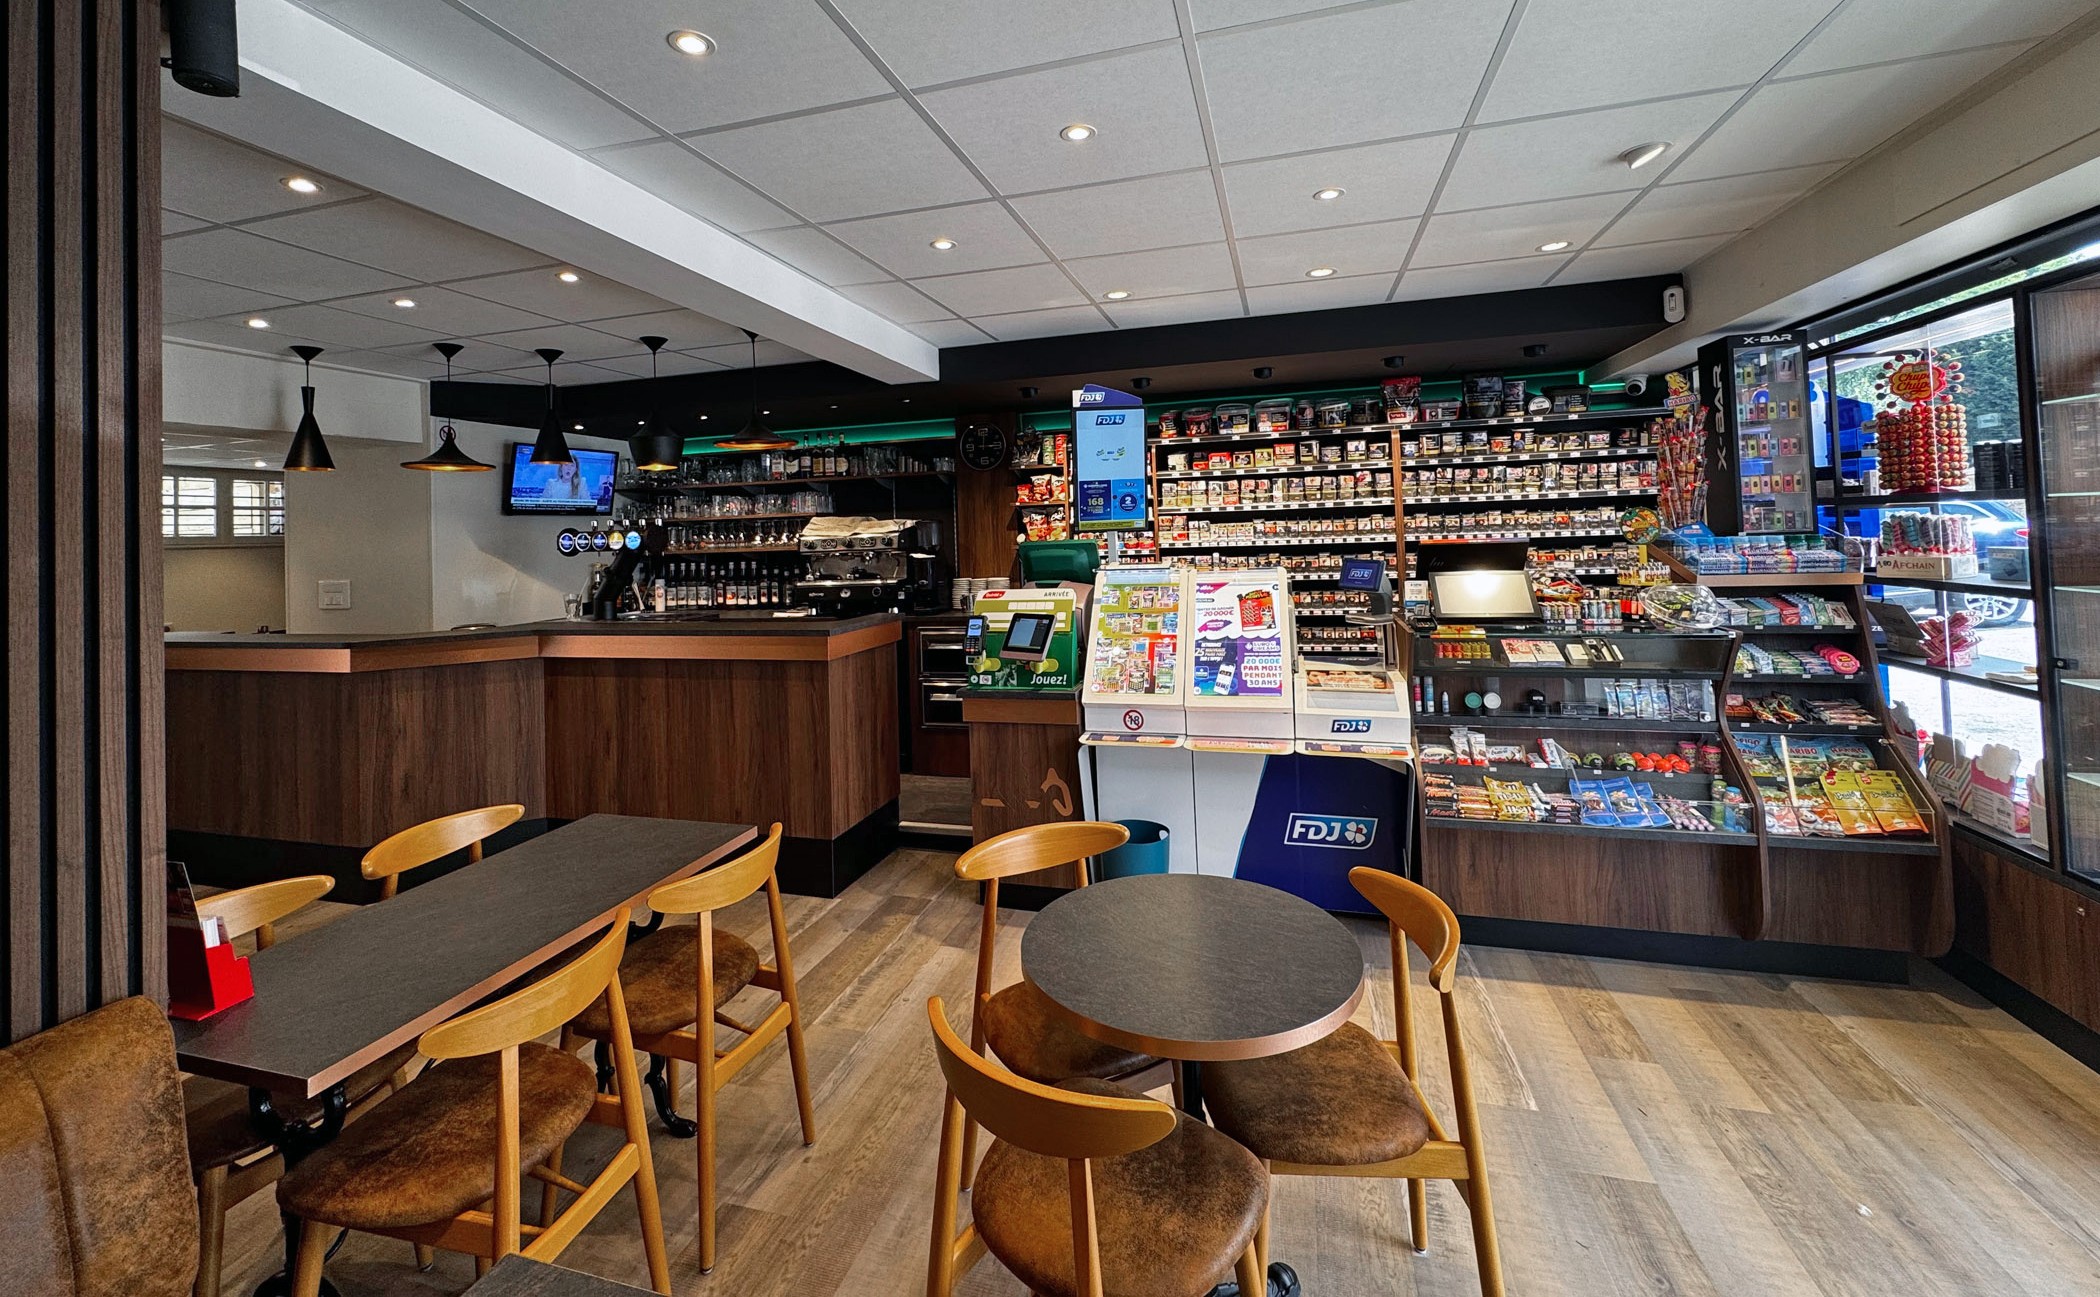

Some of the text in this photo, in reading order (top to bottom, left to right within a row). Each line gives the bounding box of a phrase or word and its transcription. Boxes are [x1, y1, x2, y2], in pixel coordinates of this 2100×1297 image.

[1743, 333, 1793, 345] X-BAR
[1080, 394, 1095, 402] FDJ
[1097, 416, 1115, 425] FDJ
[1712, 363, 1728, 471] X-BAR
[1087, 497, 1104, 506] 168
[1891, 558, 1935, 570] AFCHAIN
[1349, 569, 1363, 578] FDJ
[1194, 648, 1205, 657] 25
[1030, 674, 1067, 685] Jouez!
[1333, 721, 1357, 732] FDJ
[1789, 747, 1818, 755] ARIBO
[1292, 820, 1342, 842] FDJ
